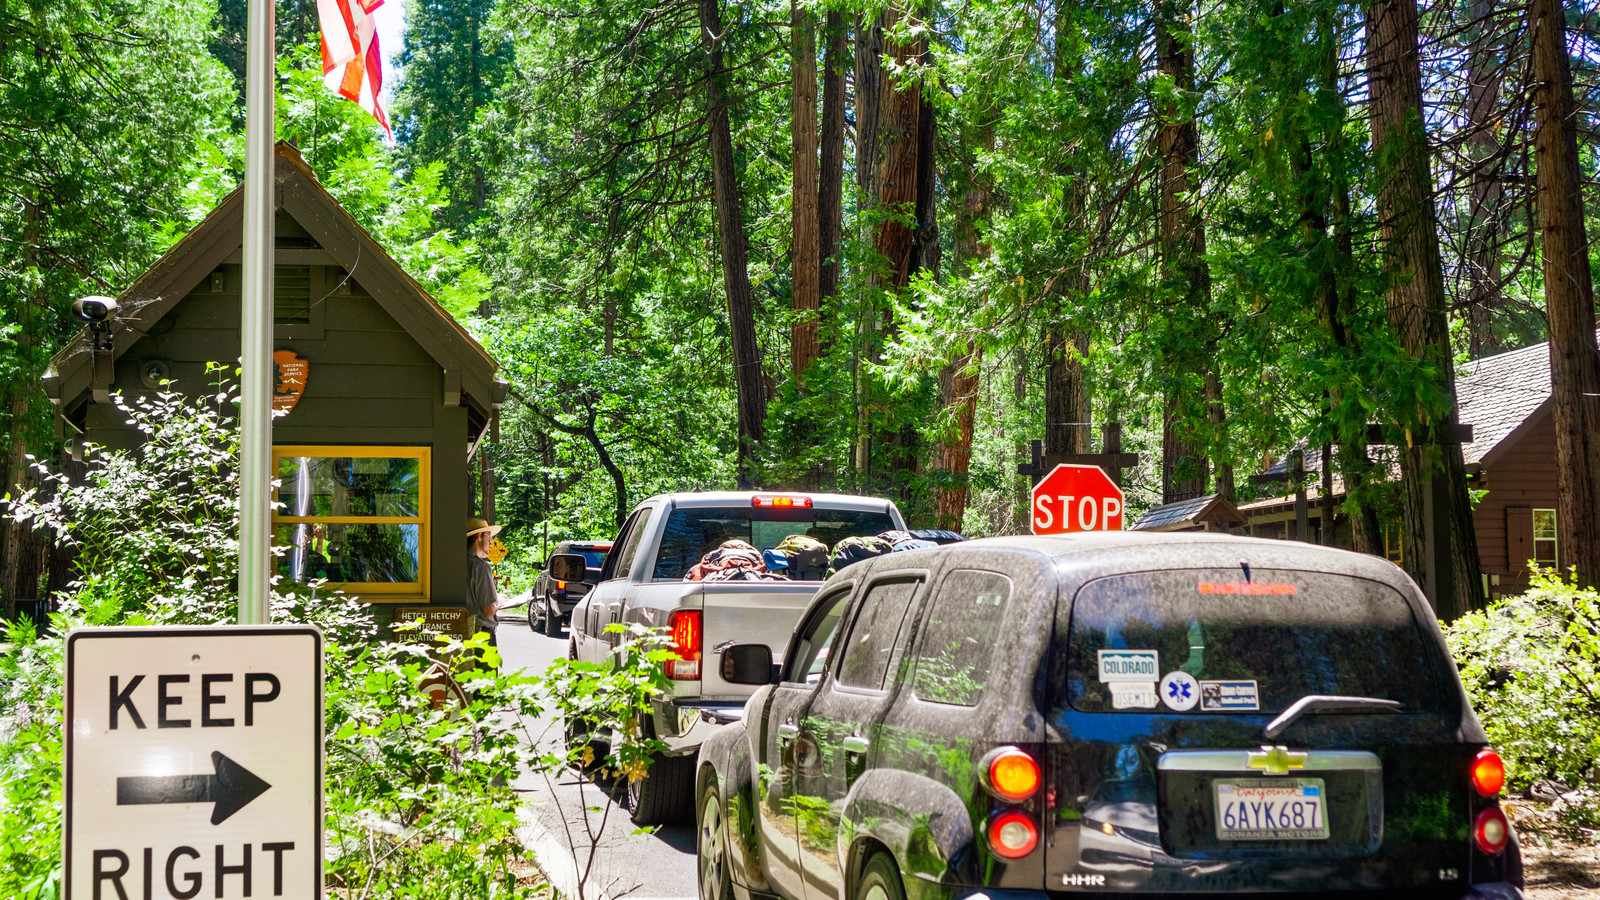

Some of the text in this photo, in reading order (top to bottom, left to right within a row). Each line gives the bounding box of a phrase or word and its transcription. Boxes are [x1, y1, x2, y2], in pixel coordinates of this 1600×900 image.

[1035, 494, 1121, 531] STOP
[430, 612, 461, 620] HETCHY
[1104, 661, 1154, 674] COLORADO
[109, 672, 281, 730] KEEP
[1224, 801, 1317, 831] 6AYK687
[93, 842, 295, 900] RIGHT
[1062, 874, 1105, 886] HHR
